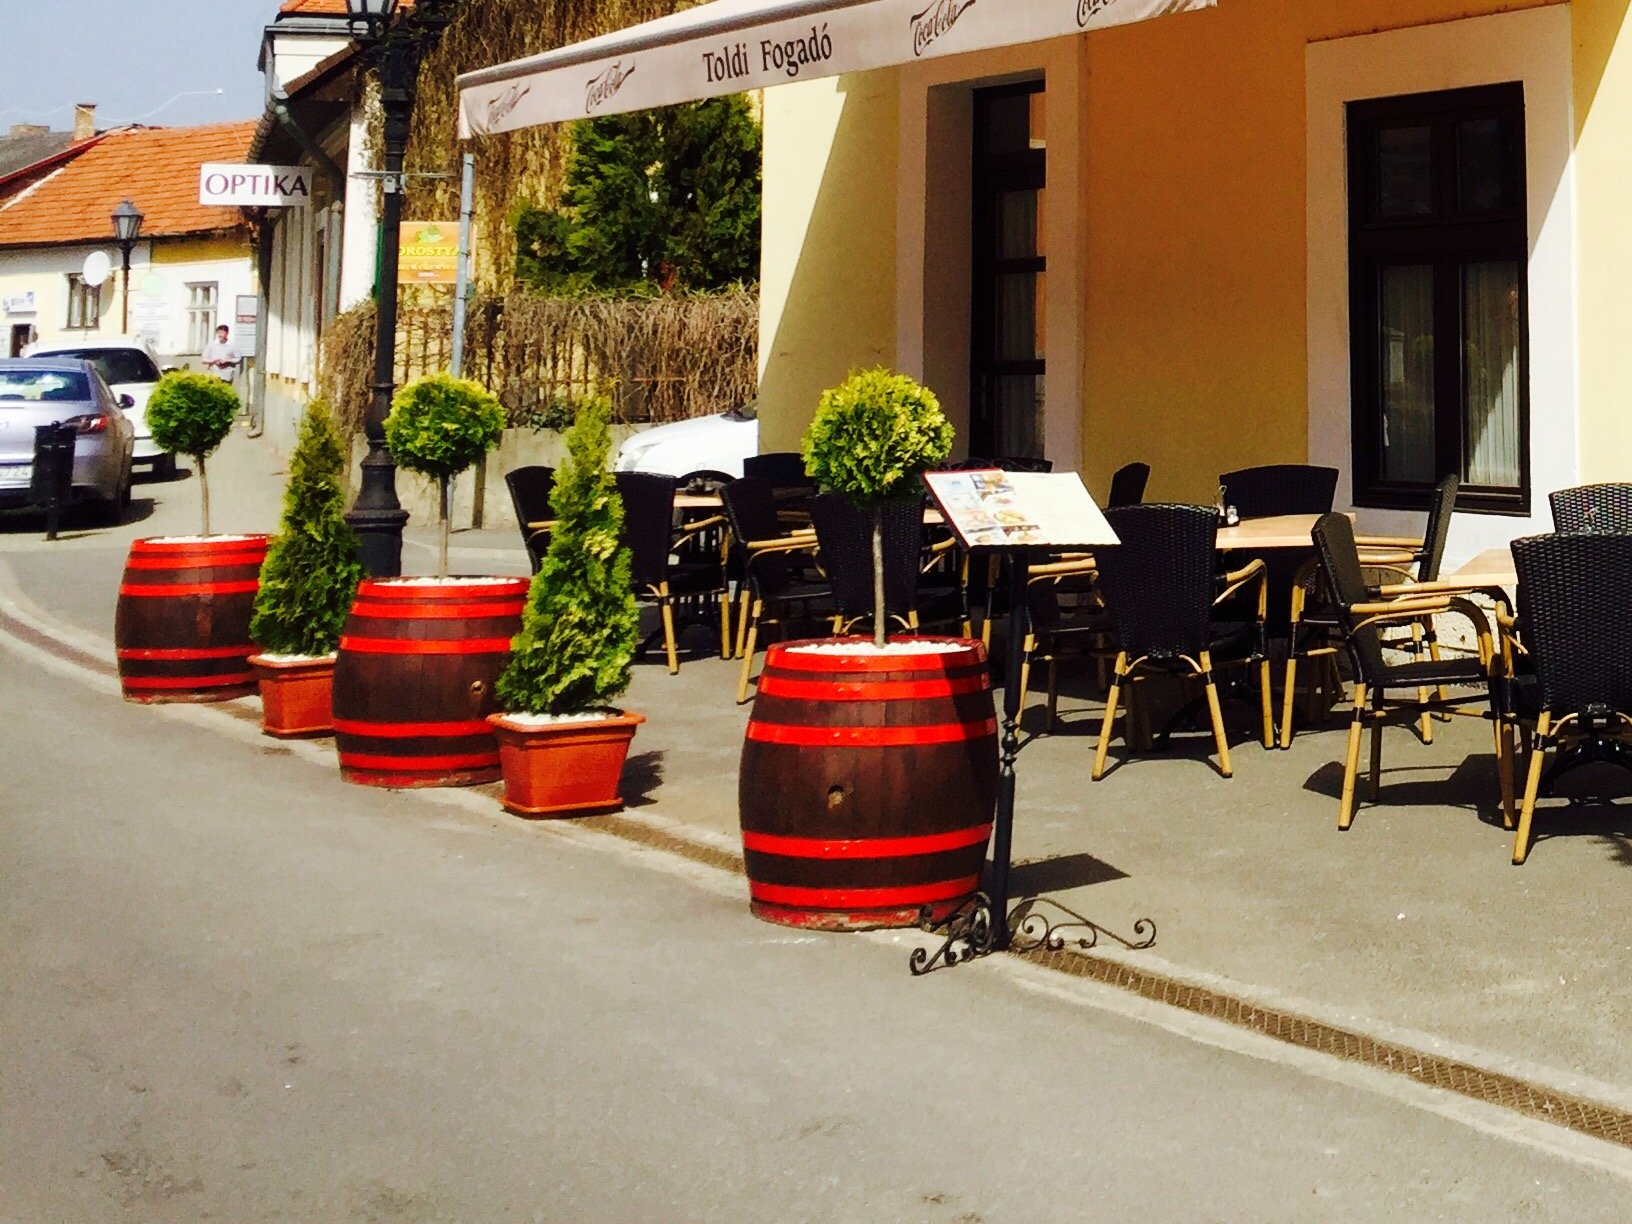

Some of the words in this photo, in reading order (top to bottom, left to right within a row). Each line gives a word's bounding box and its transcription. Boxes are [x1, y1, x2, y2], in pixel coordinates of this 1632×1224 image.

[702, 42, 749, 82] Toldi
[760, 22, 832, 77] Fogadó
[205, 173, 309, 196] OPTIKA
